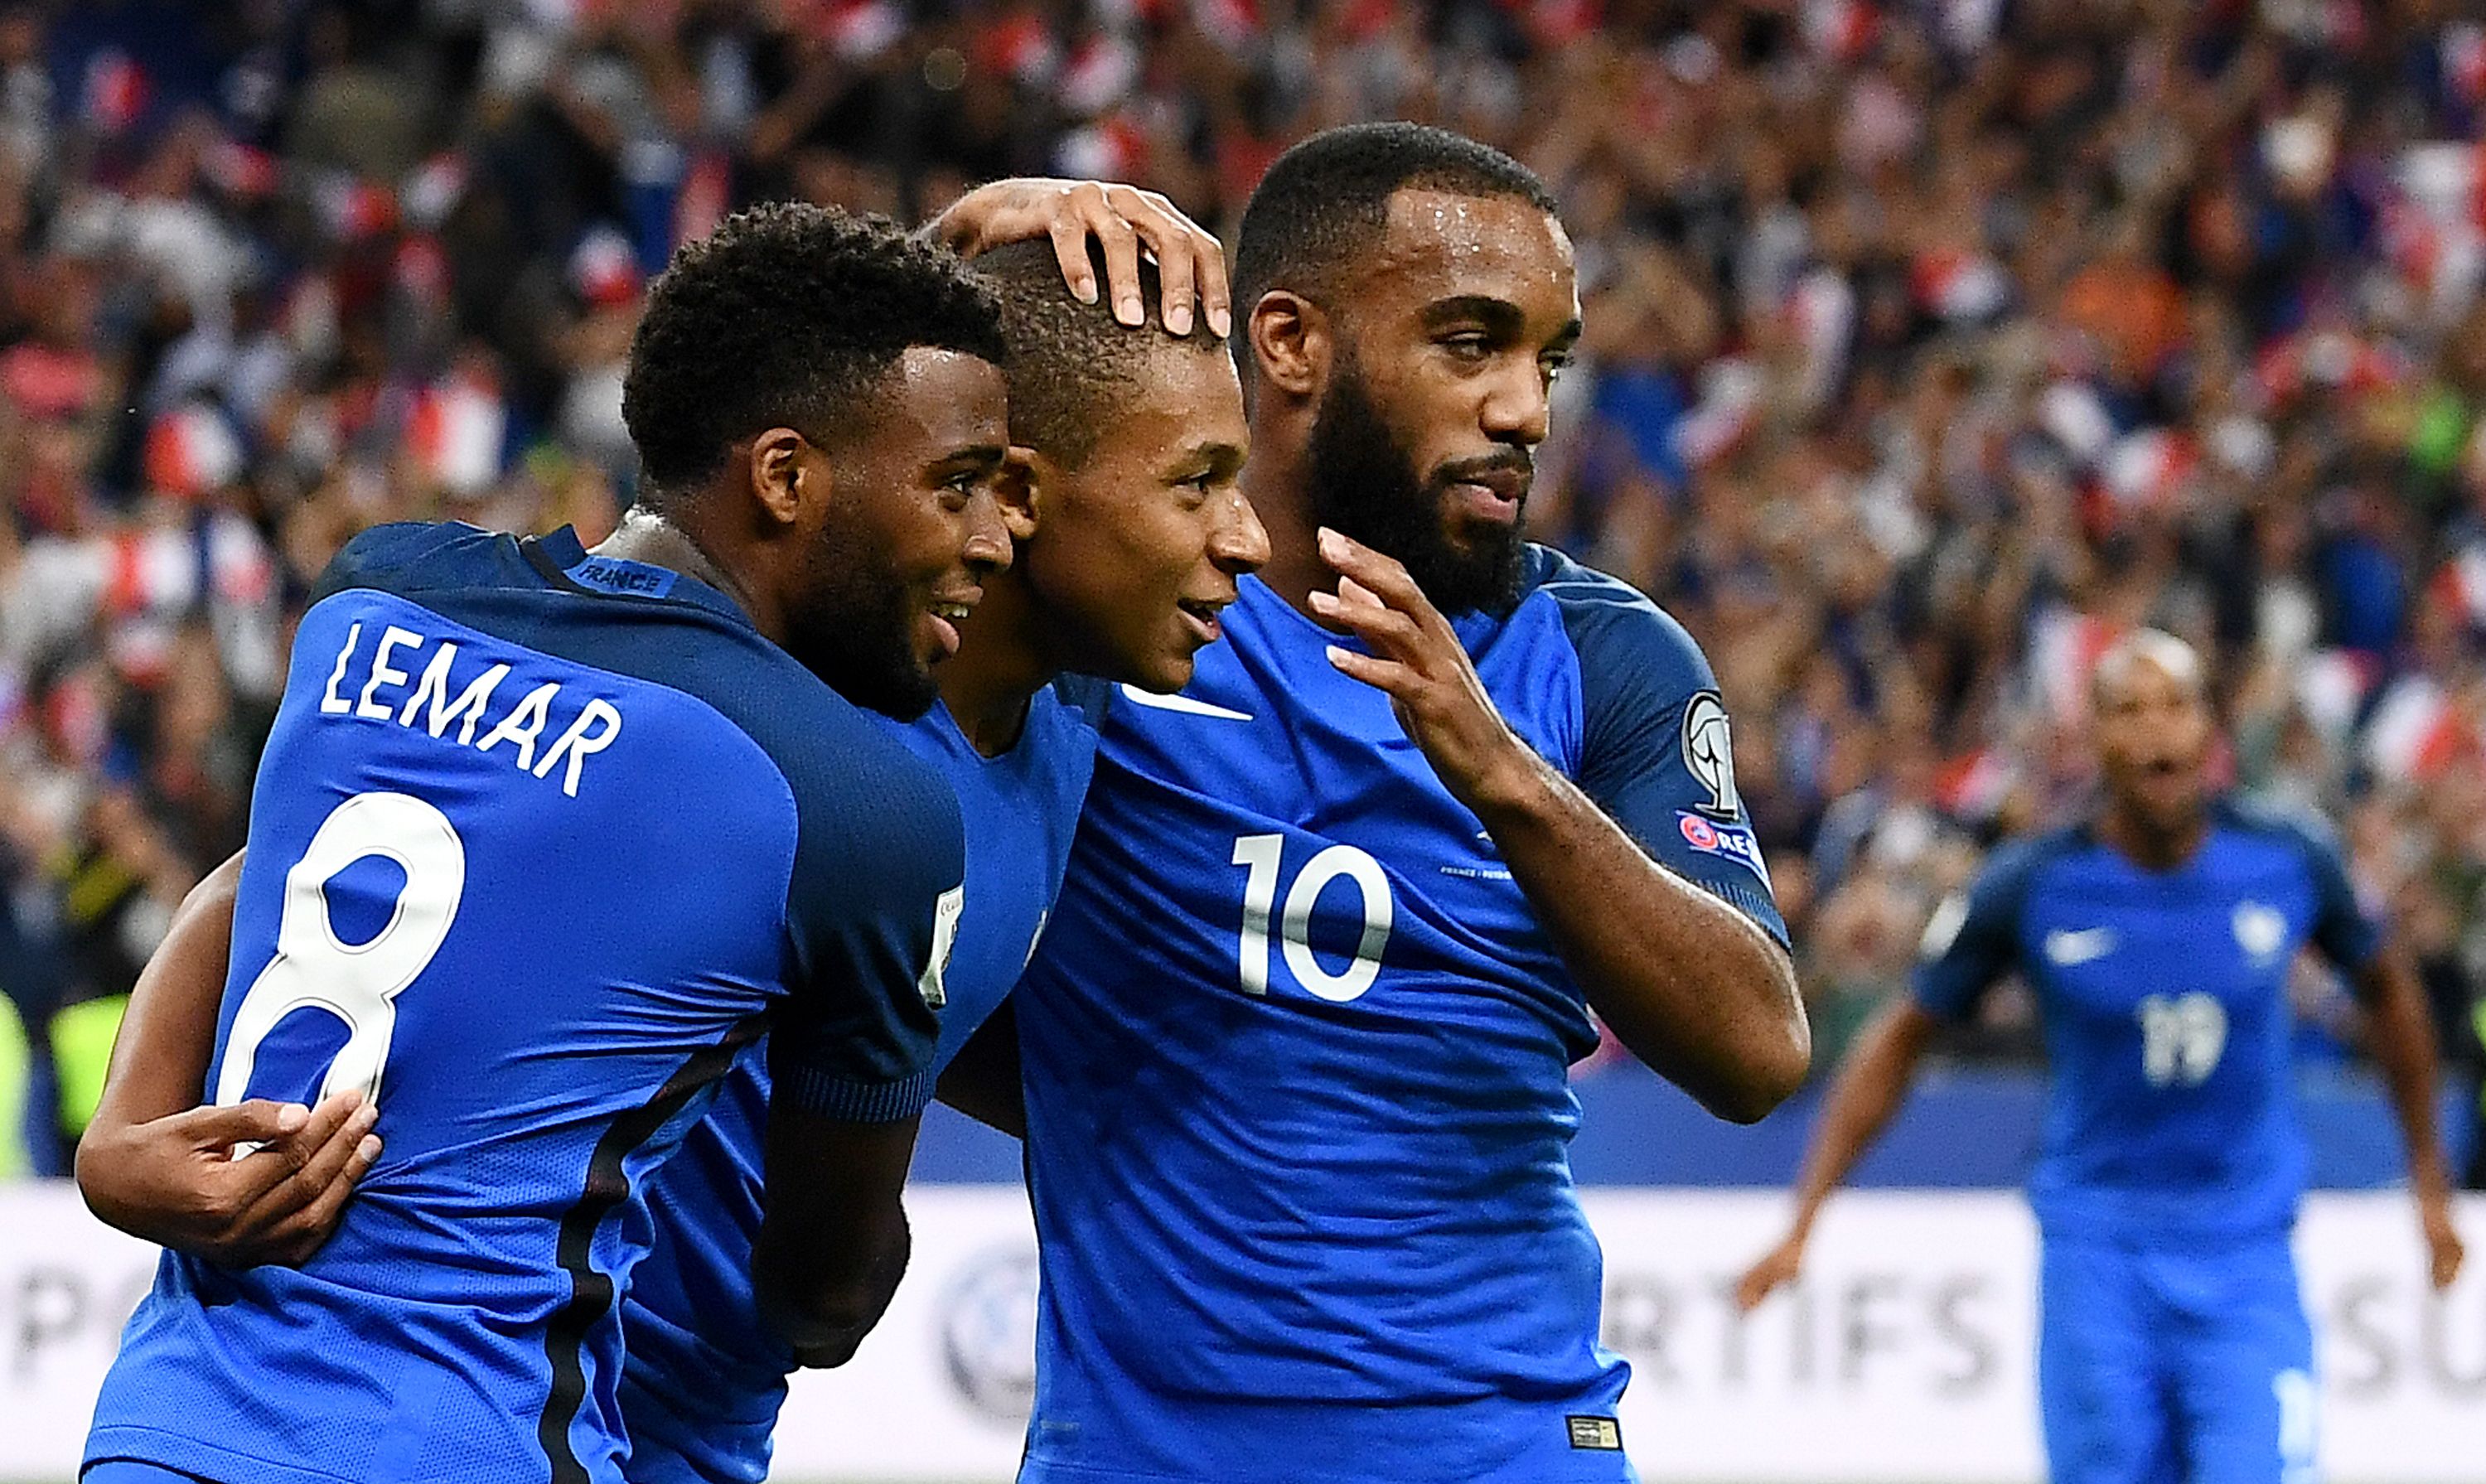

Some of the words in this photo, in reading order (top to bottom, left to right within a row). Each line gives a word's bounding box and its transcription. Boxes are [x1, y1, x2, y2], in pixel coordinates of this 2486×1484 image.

[578, 564, 661, 592] FRANCE
[320, 622, 622, 797] LEMAR
[216, 791, 466, 1160] 8
[1231, 832, 1394, 1003] 10
[2138, 992, 2228, 1089] 19
